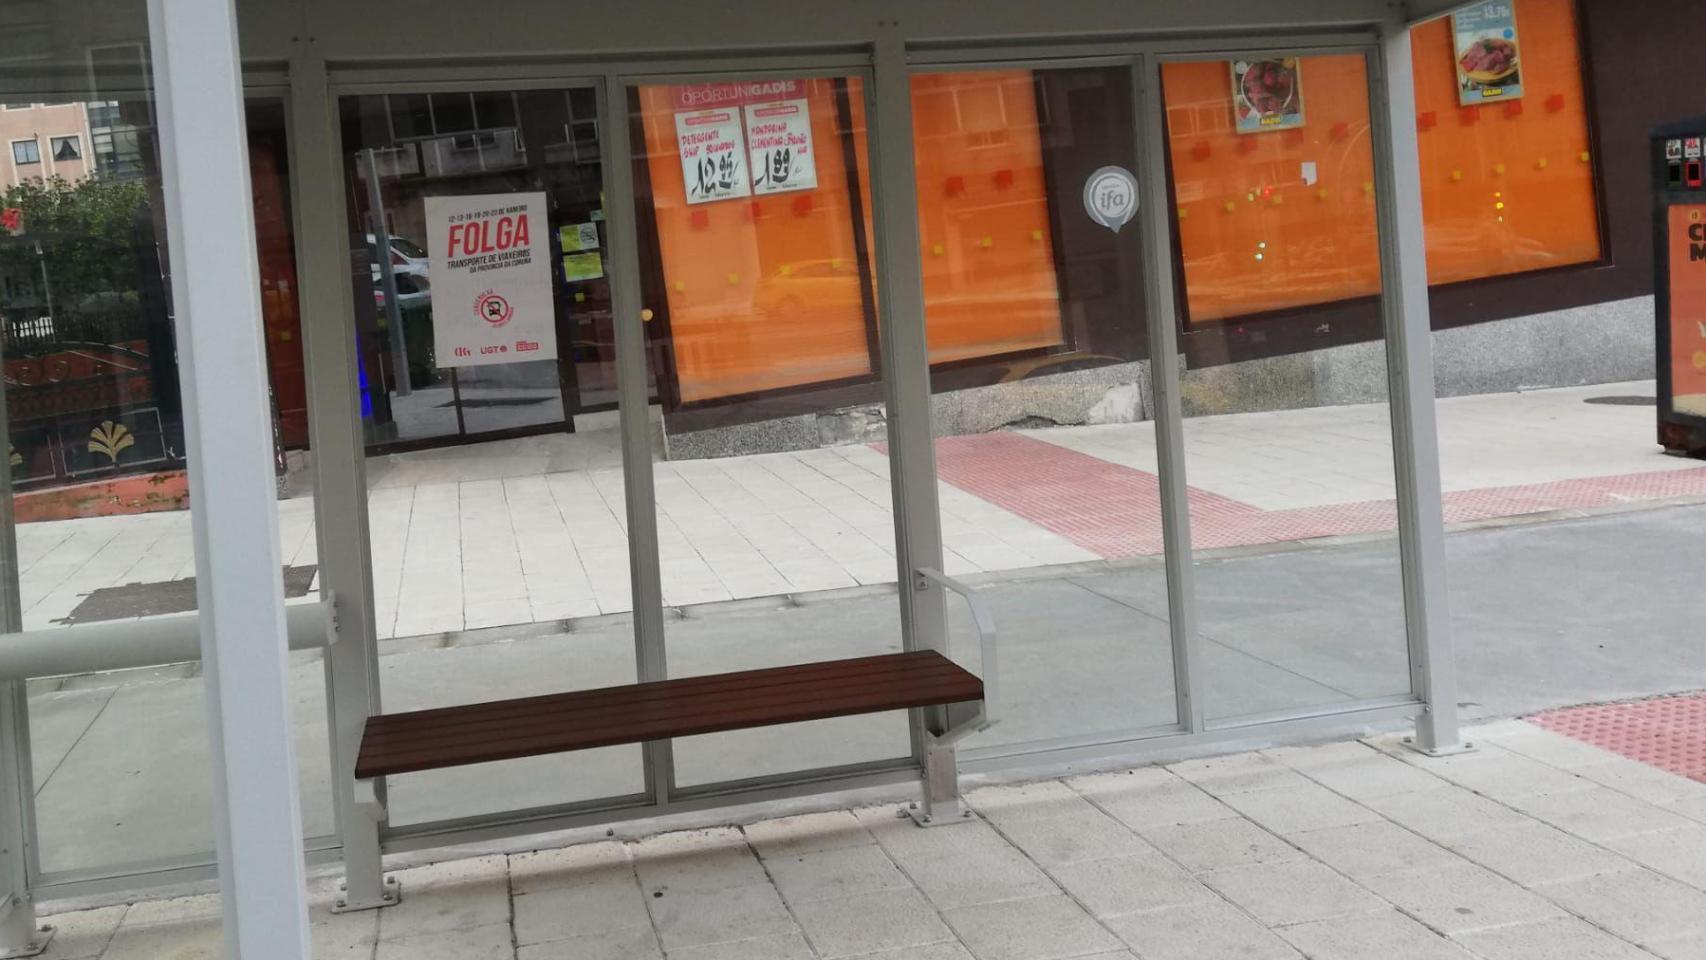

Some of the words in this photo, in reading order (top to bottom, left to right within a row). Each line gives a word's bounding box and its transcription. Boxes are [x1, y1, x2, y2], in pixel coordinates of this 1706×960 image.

[1101, 189, 1125, 211] ifa
[448, 214, 529, 258] FOLGA
[447, 255, 488, 270] TRANSPORTE
[488, 253, 497, 263] DE
[498, 248, 530, 262] VIAXEIROS
[480, 345, 499, 354] UGT
